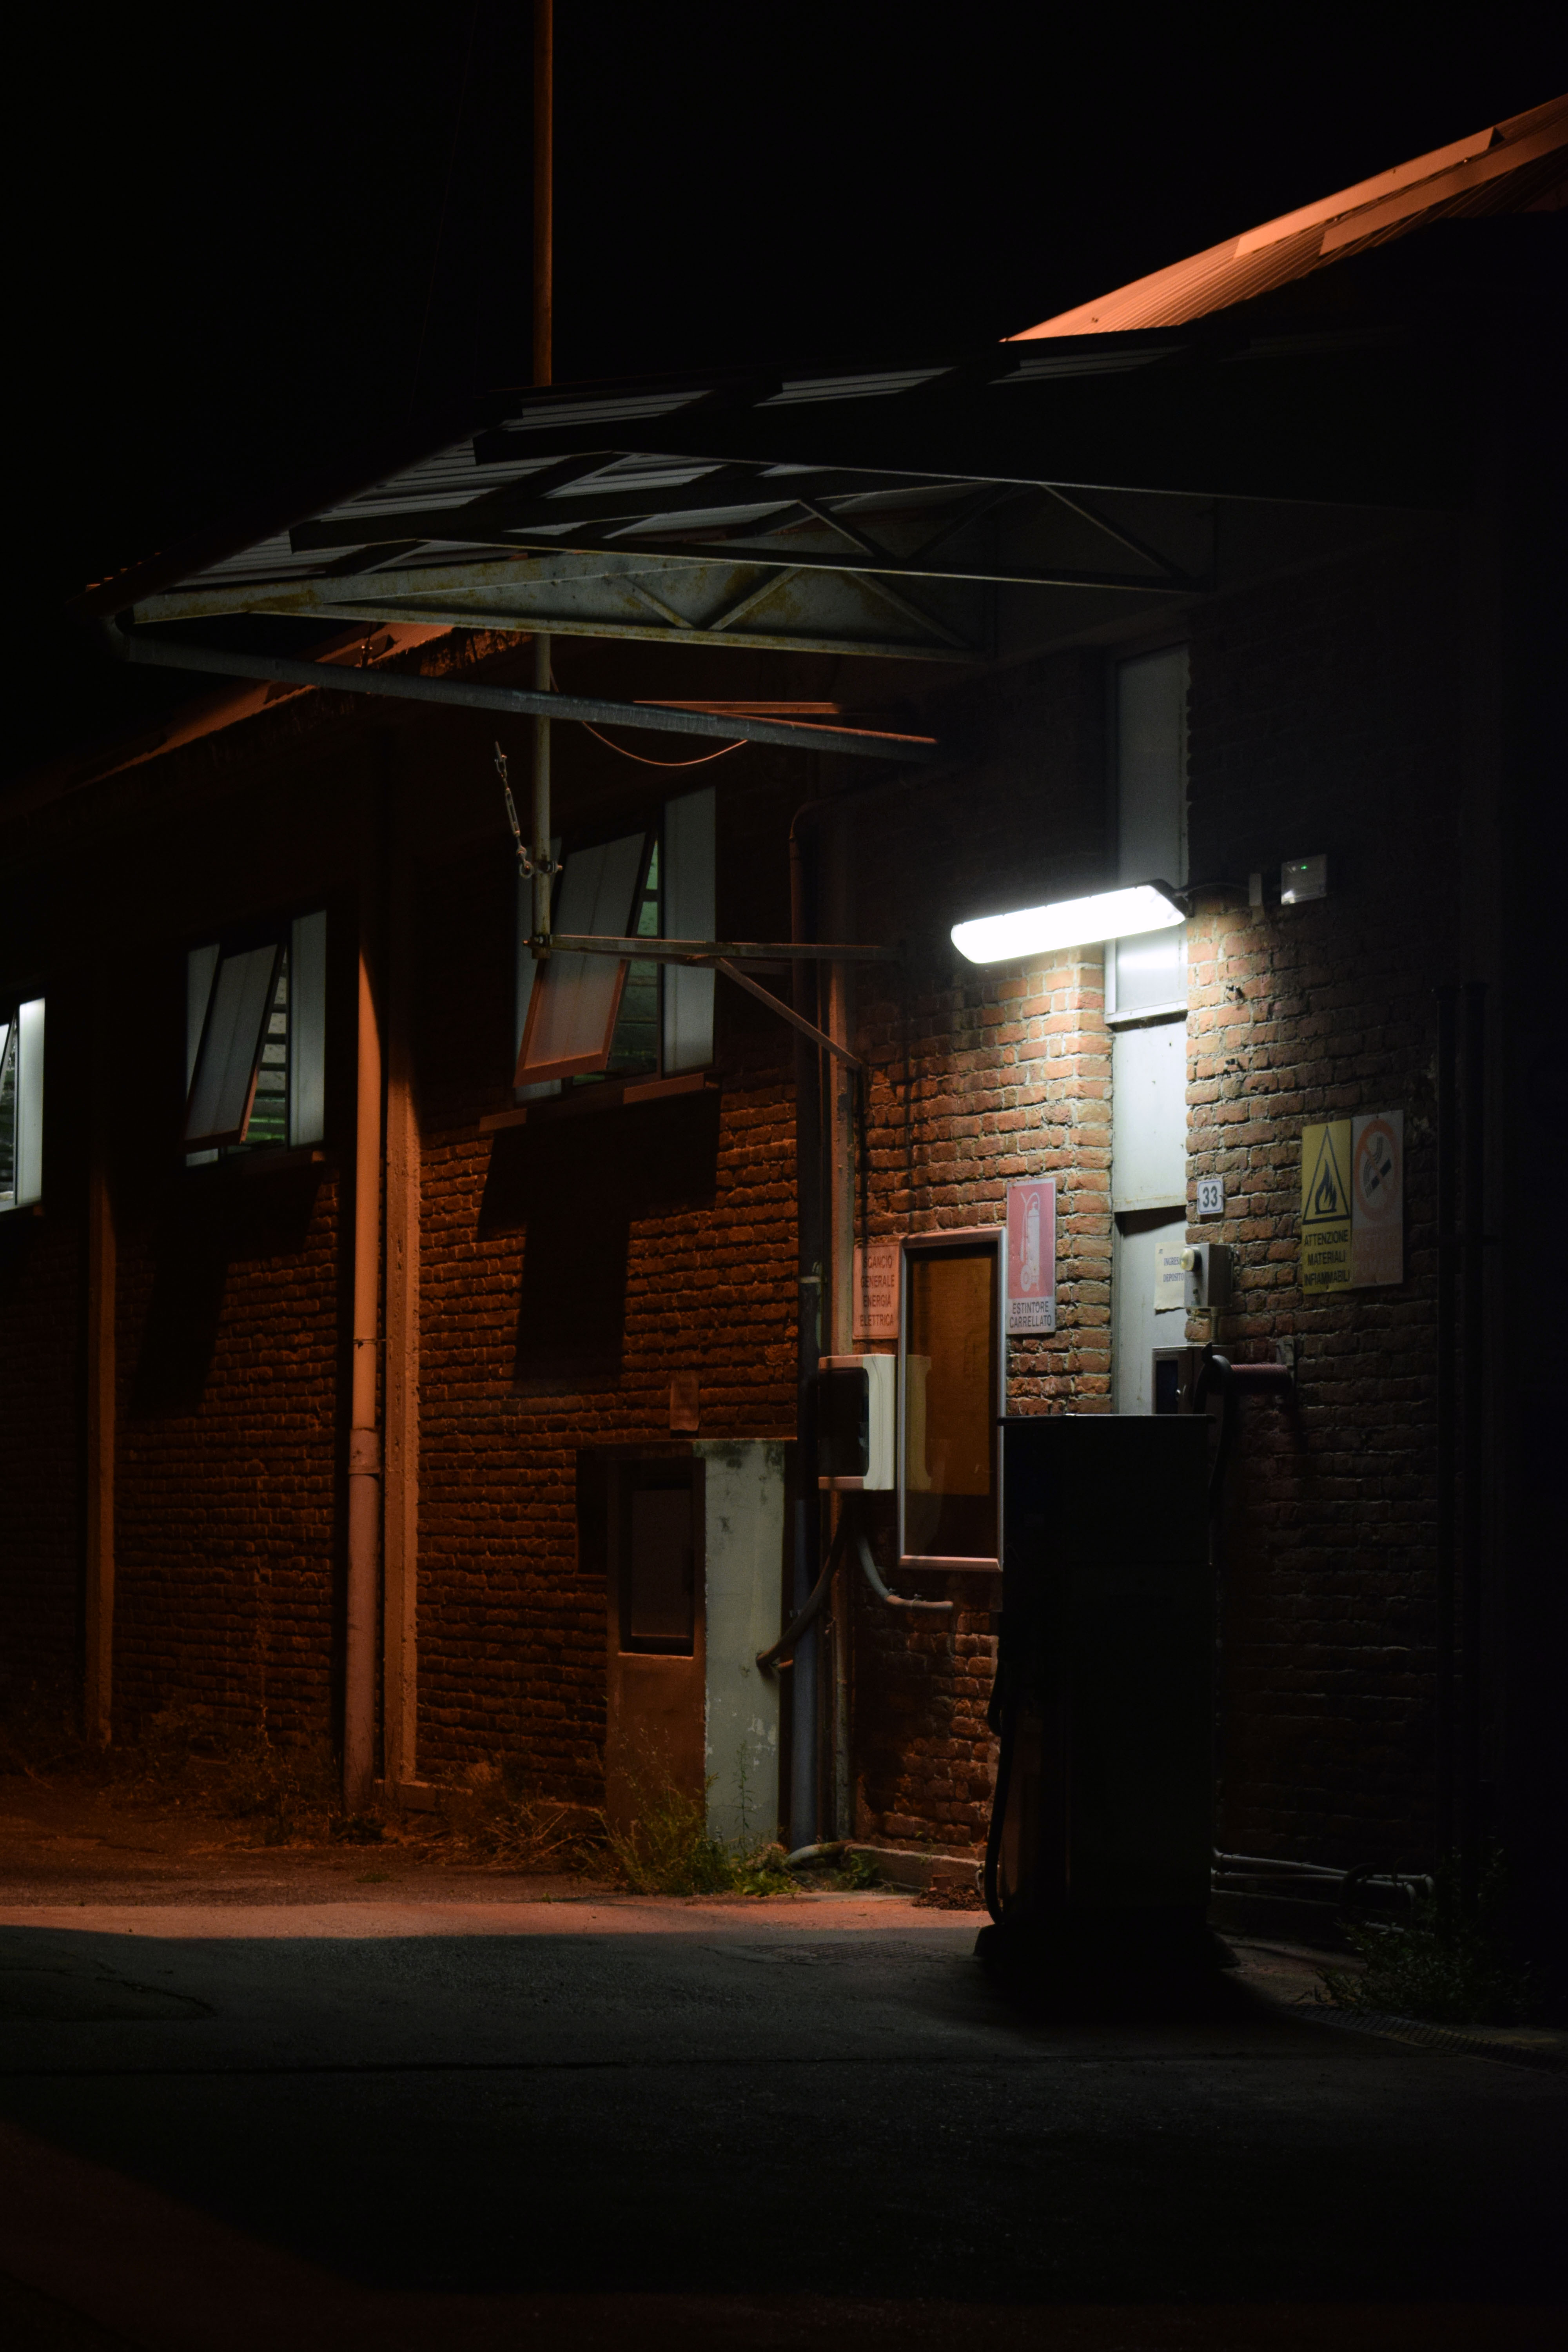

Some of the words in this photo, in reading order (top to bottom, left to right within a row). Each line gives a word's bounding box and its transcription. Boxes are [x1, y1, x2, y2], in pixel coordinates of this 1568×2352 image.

[1203, 1186, 1218, 1208] 33
[1304, 1230, 1348, 1245] ATTENZIONE
[864, 1255, 892, 1269] SGANCIO
[1163, 1257, 1180, 1266] INGRES
[1308, 1250, 1346, 1265] MATERIALI
[861, 1274, 895, 1287] GENERALE
[1163, 1273, 1184, 1282] DEPOSITO
[1304, 1269, 1350, 1286] INFIAMMABILI
[863, 1294, 891, 1307] ENERGIA
[1013, 1301, 1049, 1314] ESTINTORE
[860, 1314, 893, 1327] ELETTRICA
[1009, 1315, 1051, 1328] CARRELLATO
